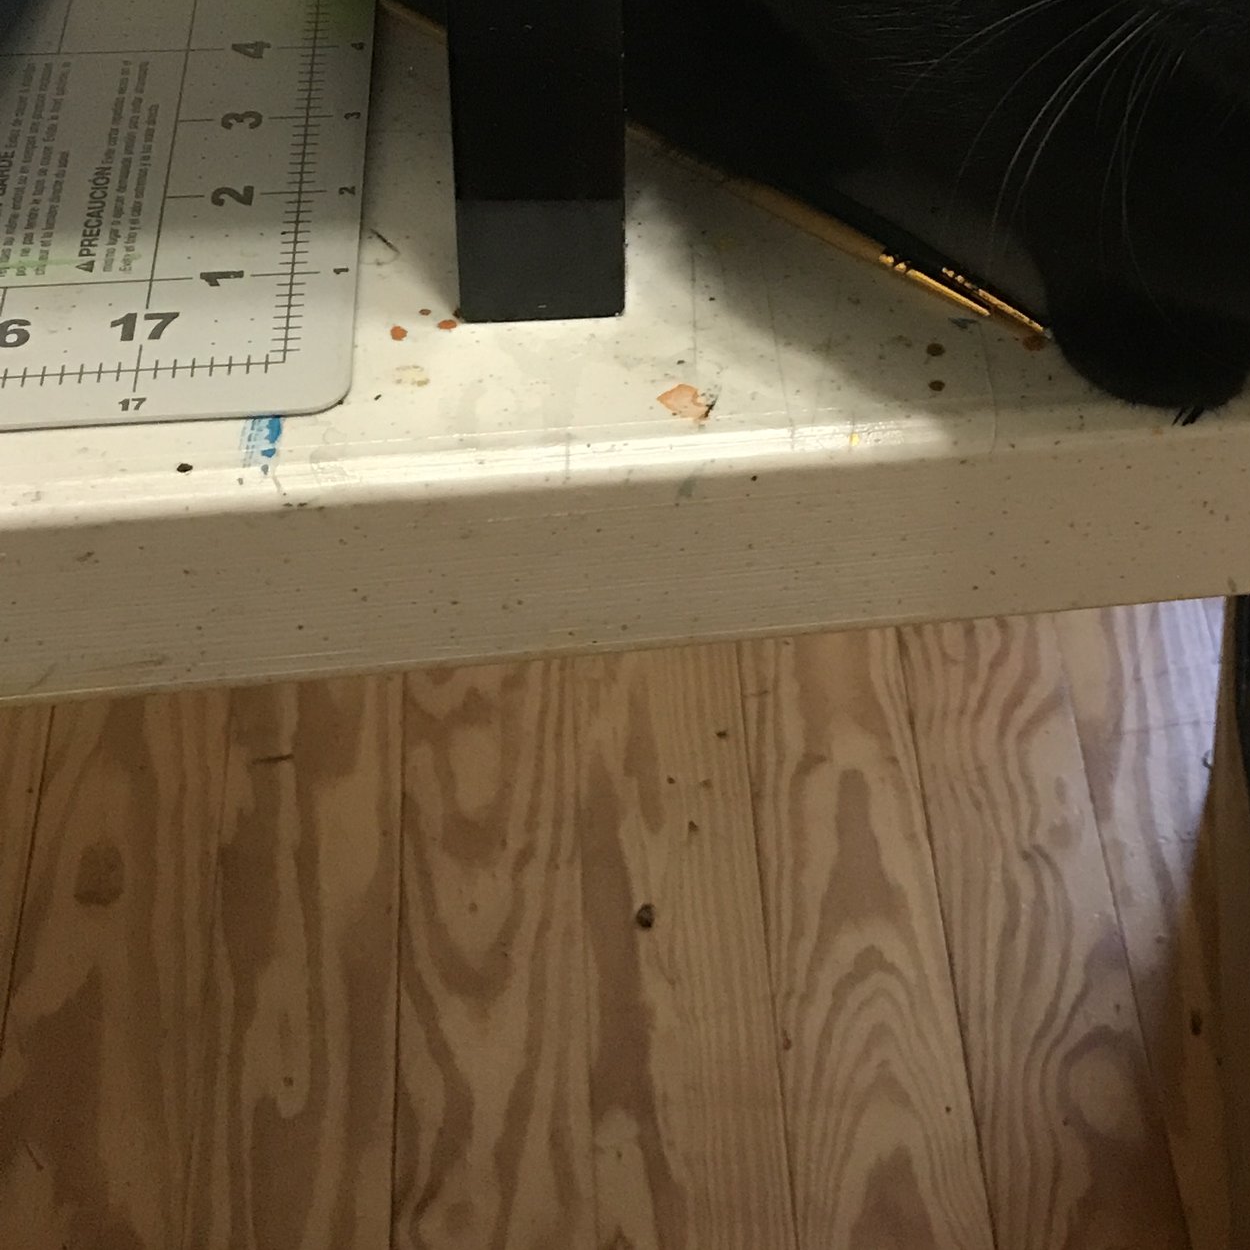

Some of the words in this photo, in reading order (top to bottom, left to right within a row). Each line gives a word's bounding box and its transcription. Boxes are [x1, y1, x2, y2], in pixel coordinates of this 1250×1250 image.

[231, 41, 272, 59] 4
[220, 111, 263, 130] 3
[344, 111, 361, 121] 3
[211, 184, 254, 206] 2
[338, 186, 356, 196] 2
[78, 166, 112, 257] PRECAUCIÓN
[200, 270, 245, 287] 1
[333, 267, 350, 275] 1
[110, 312, 180, 342] 17
[118, 398, 147, 412] 17
